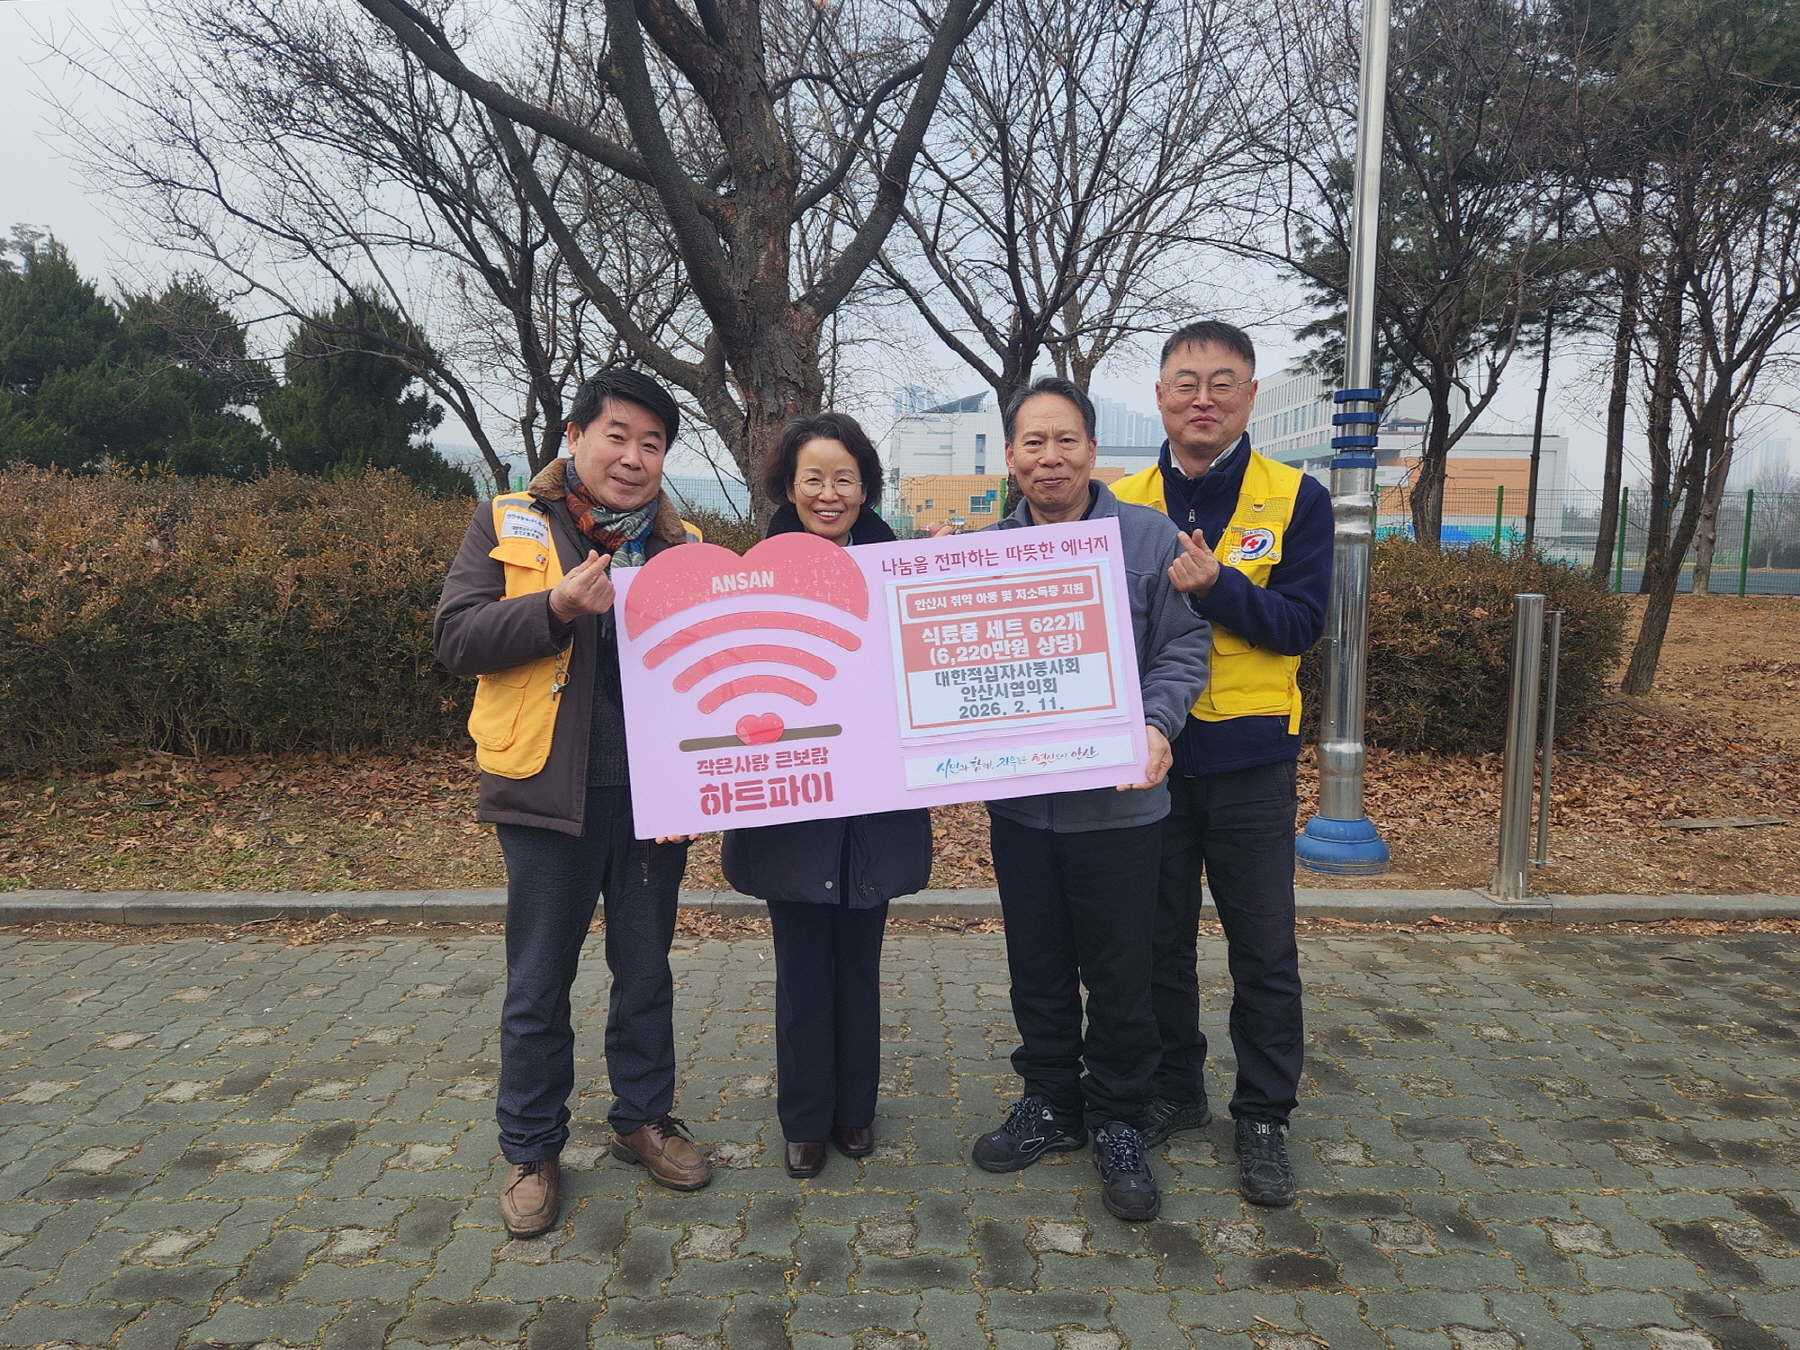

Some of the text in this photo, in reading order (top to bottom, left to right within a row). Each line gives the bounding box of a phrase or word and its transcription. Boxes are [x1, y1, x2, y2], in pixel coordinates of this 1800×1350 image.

[881, 535, 1109, 576] 나눔을 전파하는 따뜻한 에너지
[711, 570, 774, 594] ANSAN
[914, 582, 1084, 611] 안산시 취약 아동 및 저소득층 지원
[922, 611, 1085, 646] 식료품 세트 622개
[930, 633, 1082, 666] (6,220만원 상당)
[935, 657, 1081, 687] 대한적십자사봉사회
[960, 677, 1058, 703] 안산시협의회
[959, 696, 1065, 720] 2026. 2. 11.
[697, 747, 829, 776] 작은사랑 큰보람
[936, 758, 968, 779] 시민과
[1070, 746, 1099, 760] 안산
[699, 771, 834, 816] 하트파이
